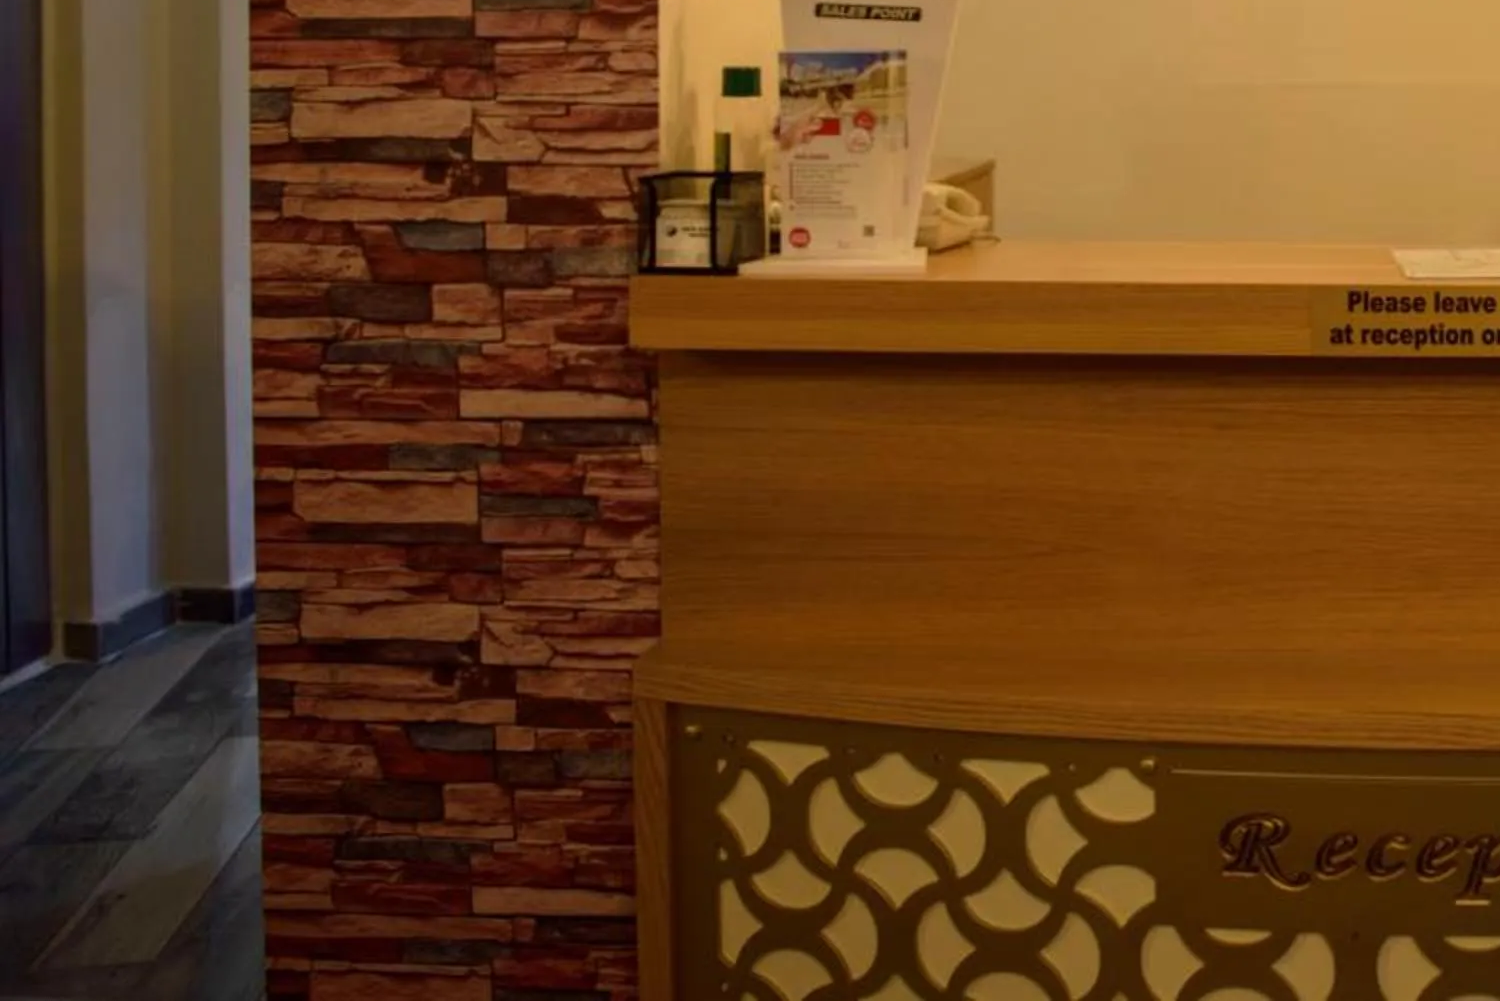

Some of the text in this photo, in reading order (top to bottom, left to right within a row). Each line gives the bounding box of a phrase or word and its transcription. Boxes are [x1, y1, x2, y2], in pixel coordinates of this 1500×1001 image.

[820, 3, 918, 20] SALES POINT
[1347, 291, 1426, 314] Please
[1434, 292, 1497, 314] leave
[1330, 325, 1354, 345] at
[1361, 324, 1474, 349] reception
